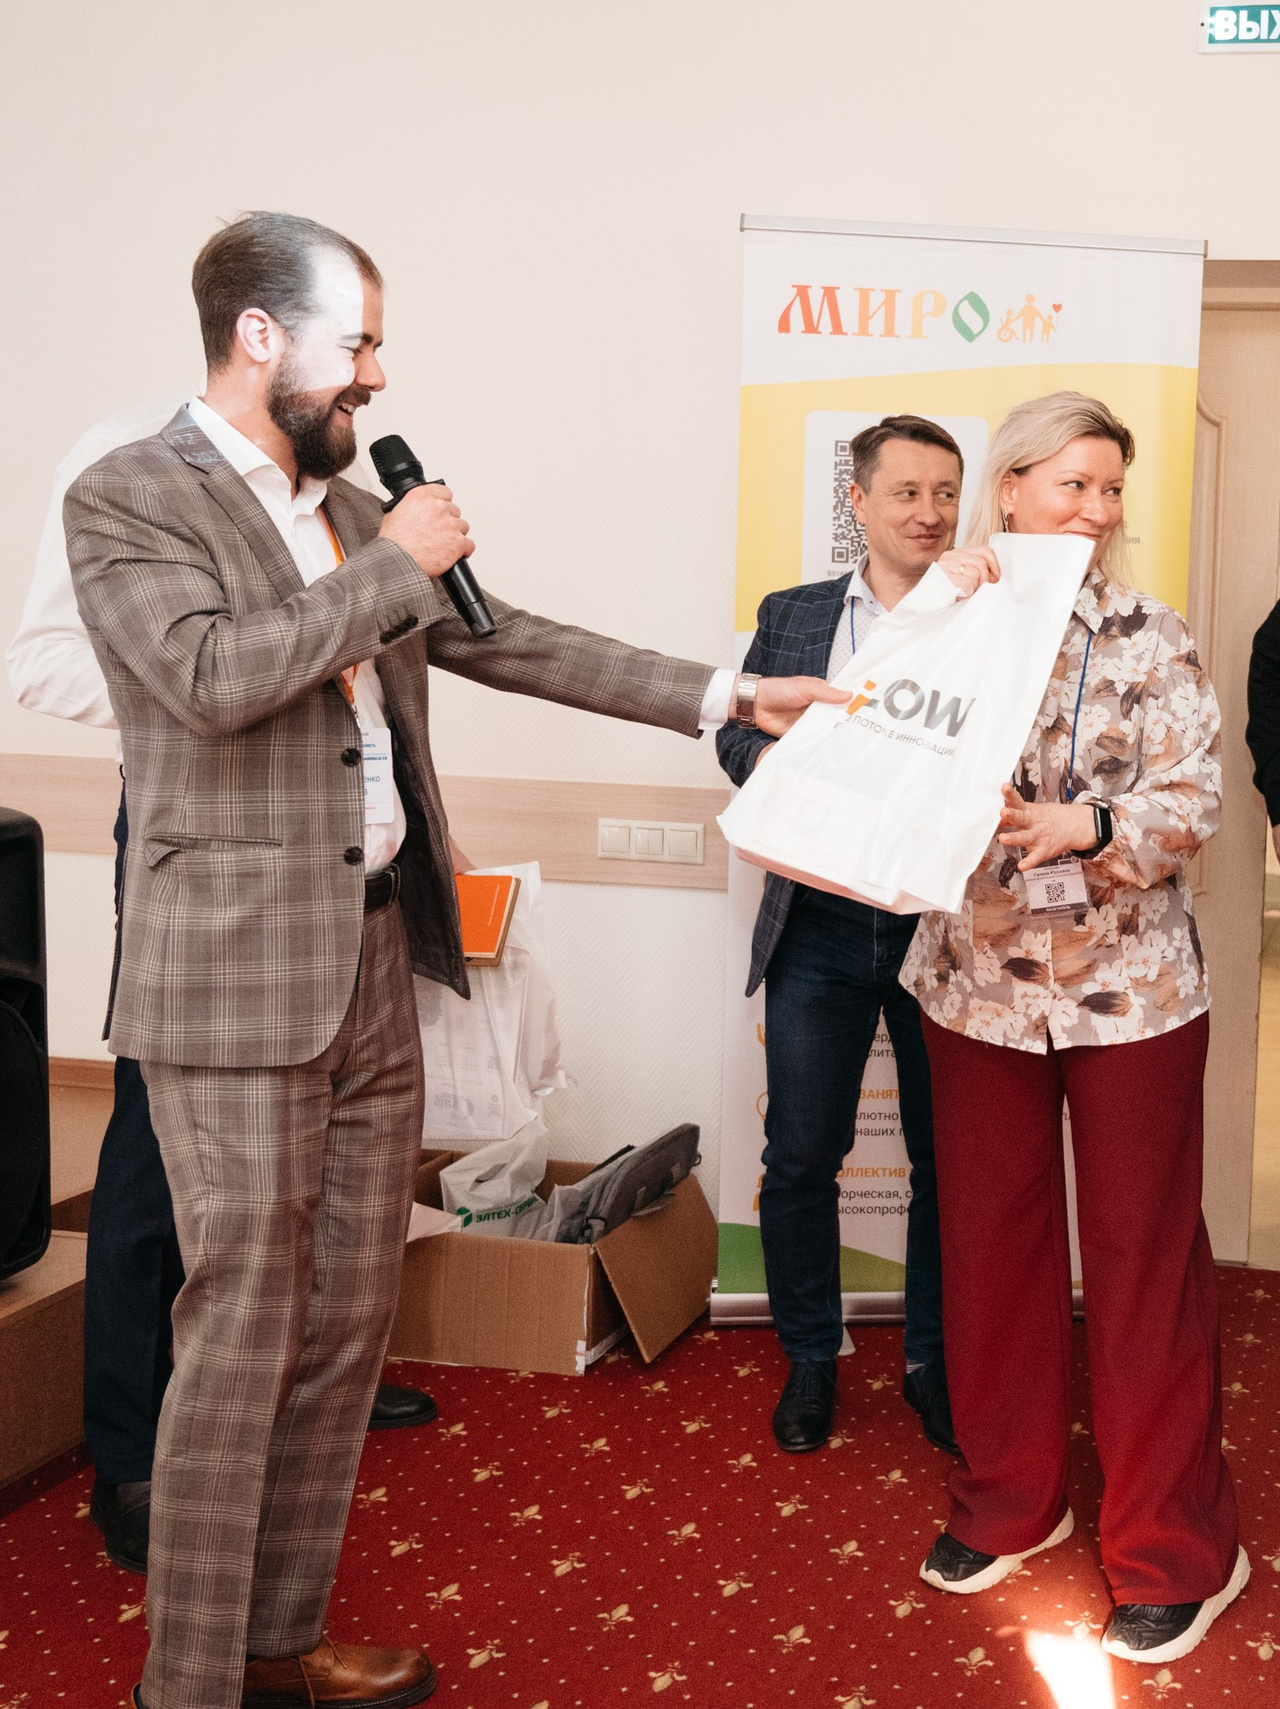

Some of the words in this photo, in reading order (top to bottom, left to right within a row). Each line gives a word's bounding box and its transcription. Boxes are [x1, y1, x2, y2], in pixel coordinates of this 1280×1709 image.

[777, 284, 990, 343] МИРО
[855, 1112, 899, 1120] лютно
[855, 1127, 895, 1137] наших
[839, 1189, 902, 1200] орческая,
